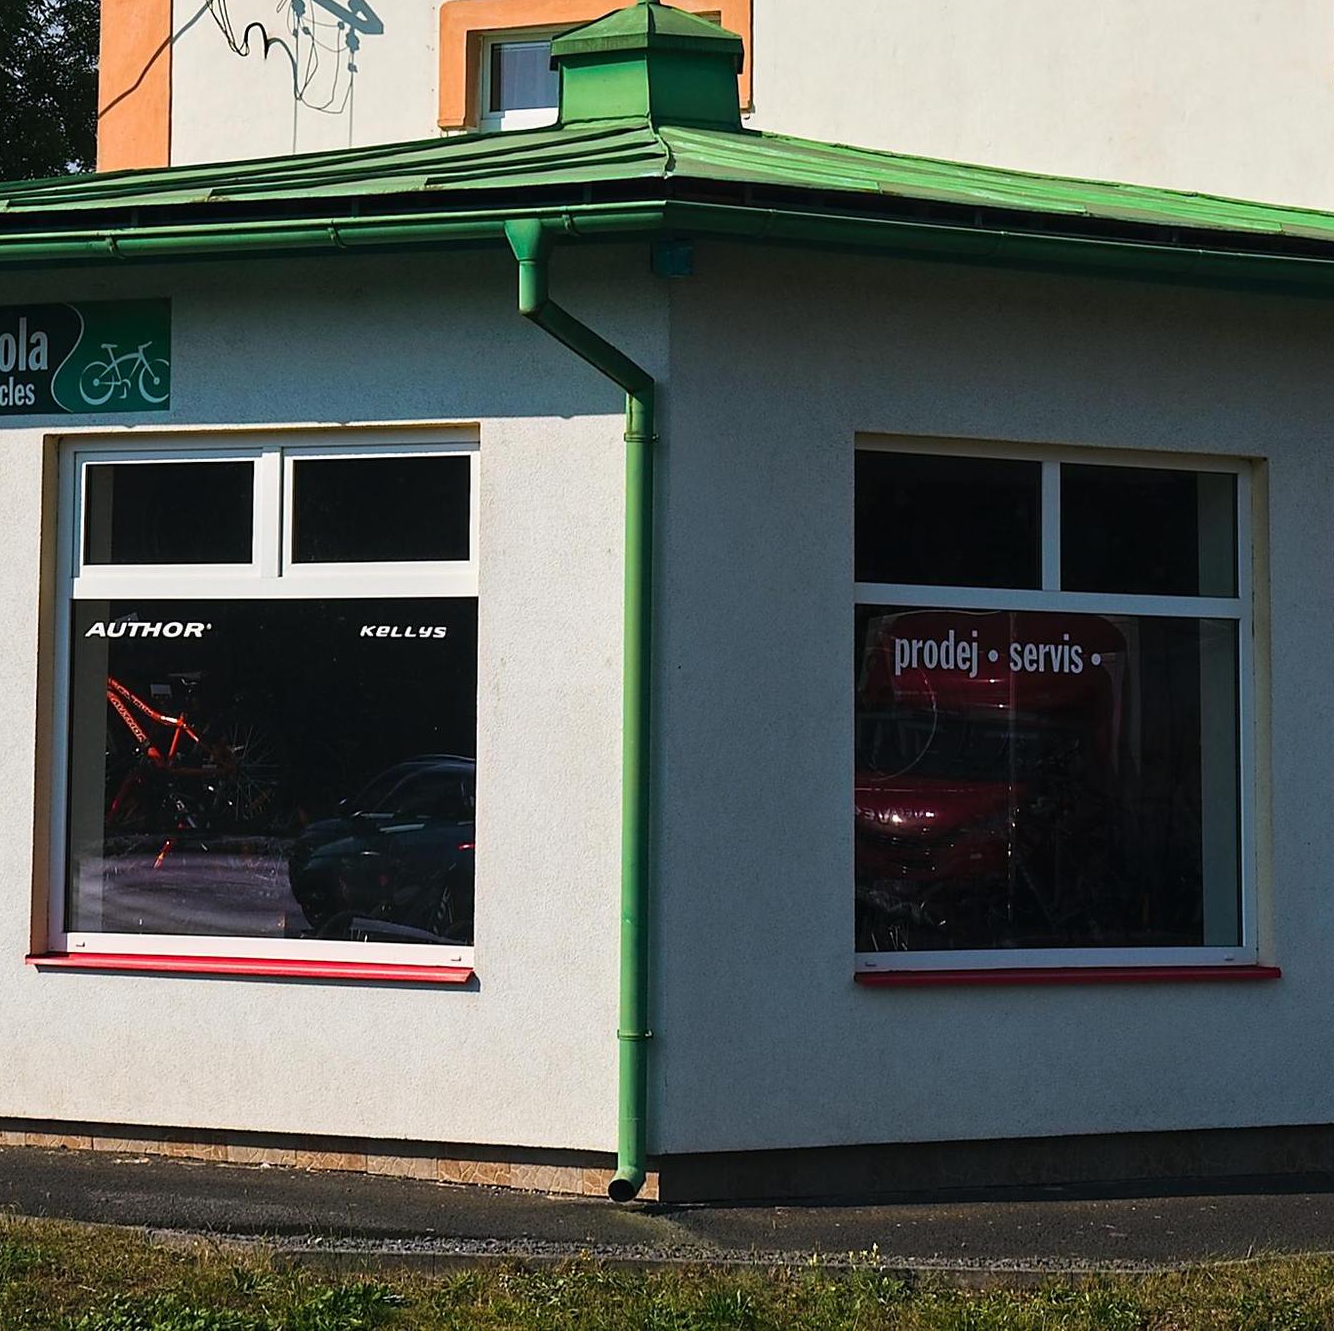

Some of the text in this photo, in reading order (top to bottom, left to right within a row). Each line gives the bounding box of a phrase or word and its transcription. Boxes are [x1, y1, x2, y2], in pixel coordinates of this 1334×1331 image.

[85, 621, 207, 638] AUTHOR
[894, 629, 1084, 679] prodej servis
